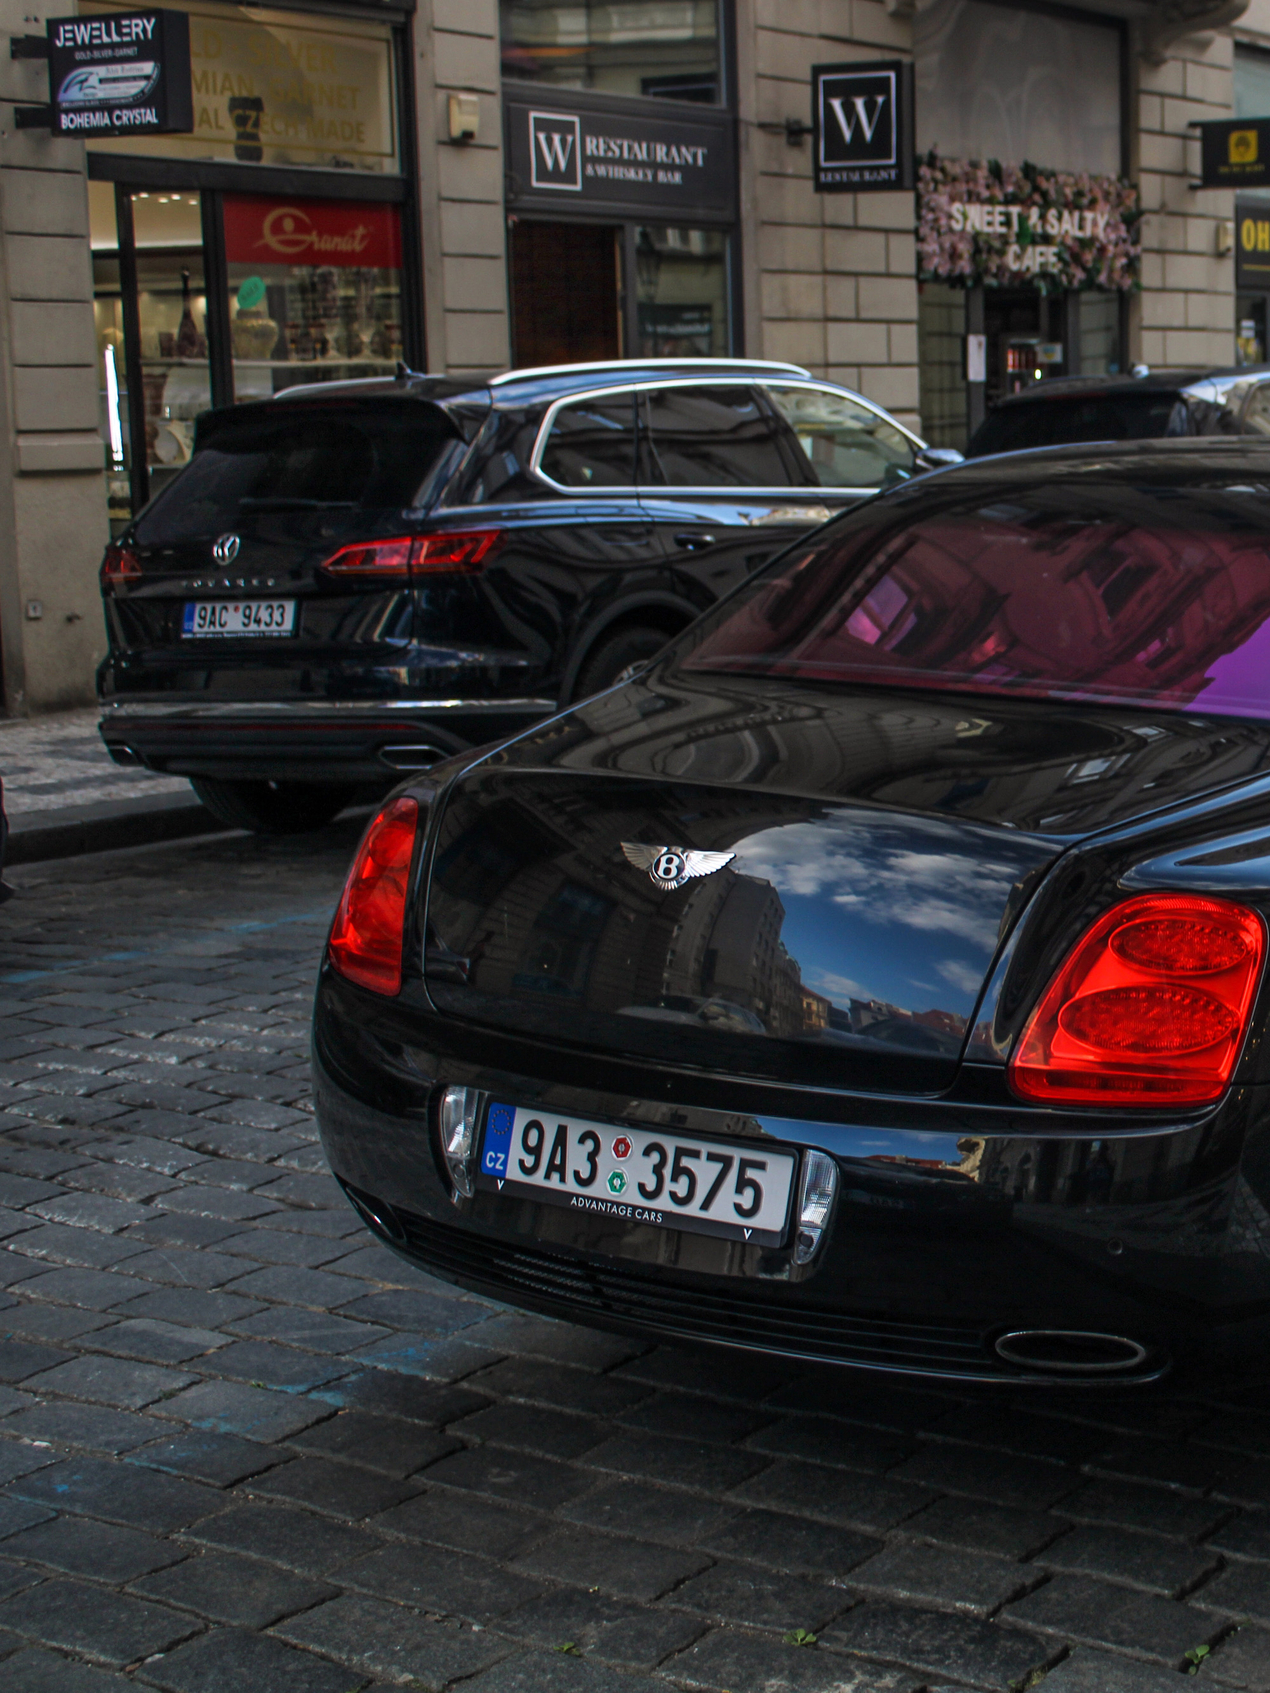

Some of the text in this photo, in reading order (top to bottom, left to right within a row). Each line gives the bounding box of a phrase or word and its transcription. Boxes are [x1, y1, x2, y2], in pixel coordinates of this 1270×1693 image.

[55, 17, 156, 47] JEWELLERY
[61, 107, 159, 130] BOHEMIA CRYSTAL
[307, 119, 366, 145] MADE
[828, 94, 887, 144] W
[536, 131, 574, 173] W
[585, 135, 708, 167] RESTAURANT
[657, 169, 682, 185] BAR
[950, 202, 1022, 234] SWEET
[1046, 207, 1109, 242] SALTY
[1241, 218, 1270, 252] OH
[1008, 243, 1060, 274] CAFE
[197, 605, 229, 629] 9AC
[242, 604, 286, 629] 9433
[656, 853, 681, 879] B
[485, 1118, 769, 1219] CZ 9A3 3575
[570, 1196, 663, 1223] ADVANTAGE CARS
